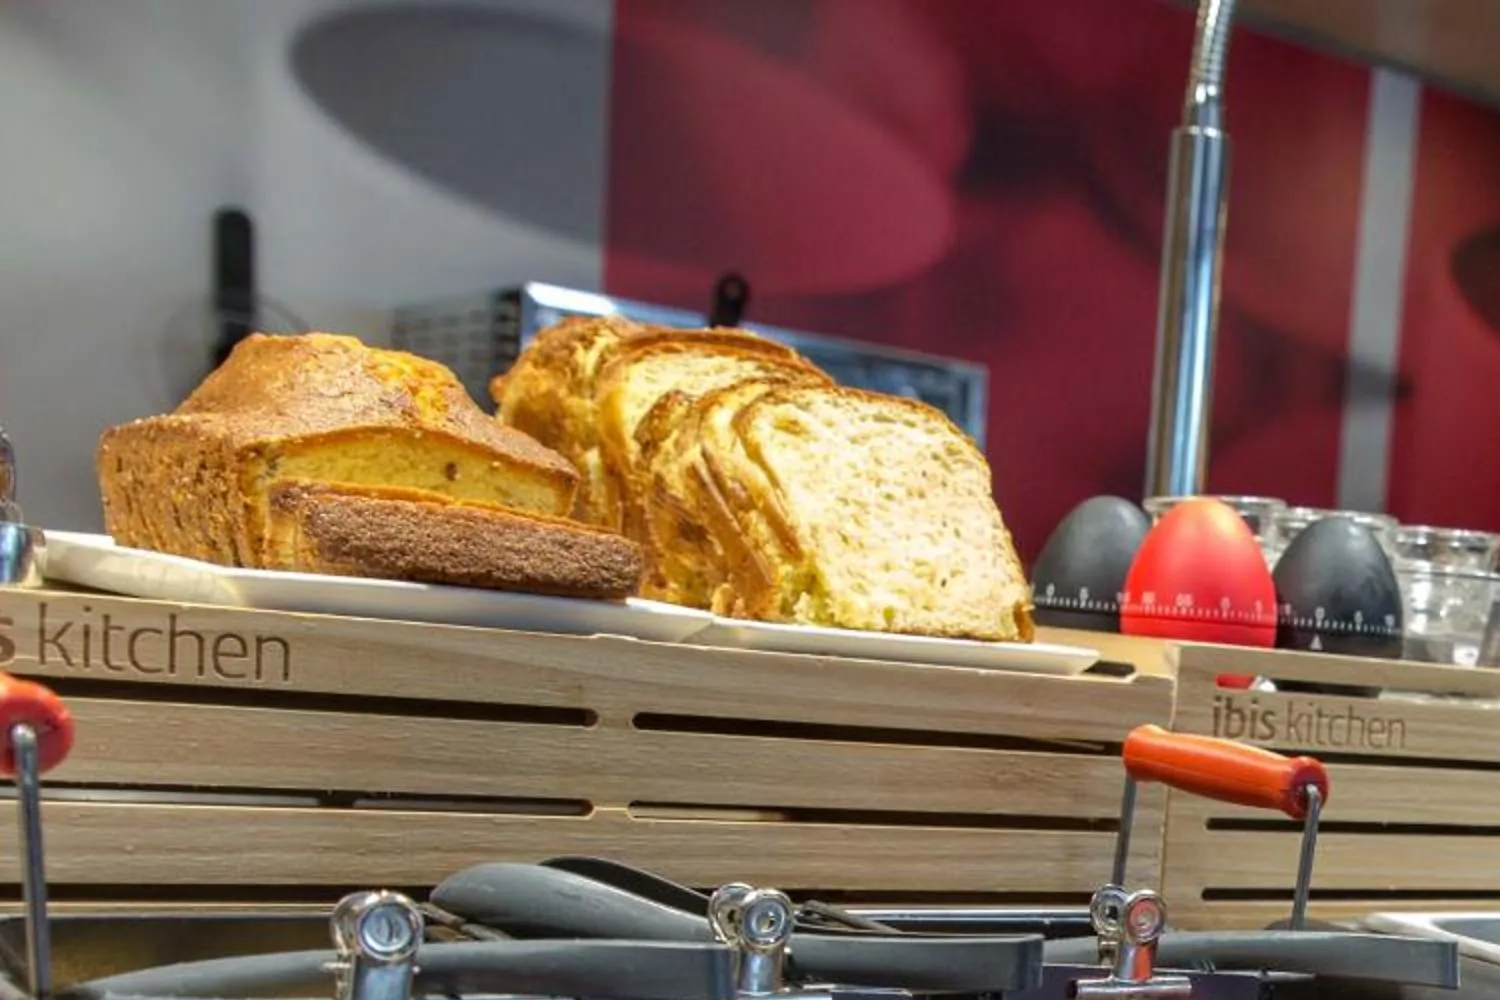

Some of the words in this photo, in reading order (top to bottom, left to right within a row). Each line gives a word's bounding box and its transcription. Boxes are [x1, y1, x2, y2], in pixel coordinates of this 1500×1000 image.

[38, 602, 291, 682] kitchen
[1211, 696, 1276, 741] ibis
[1285, 700, 1407, 748] kitchen
